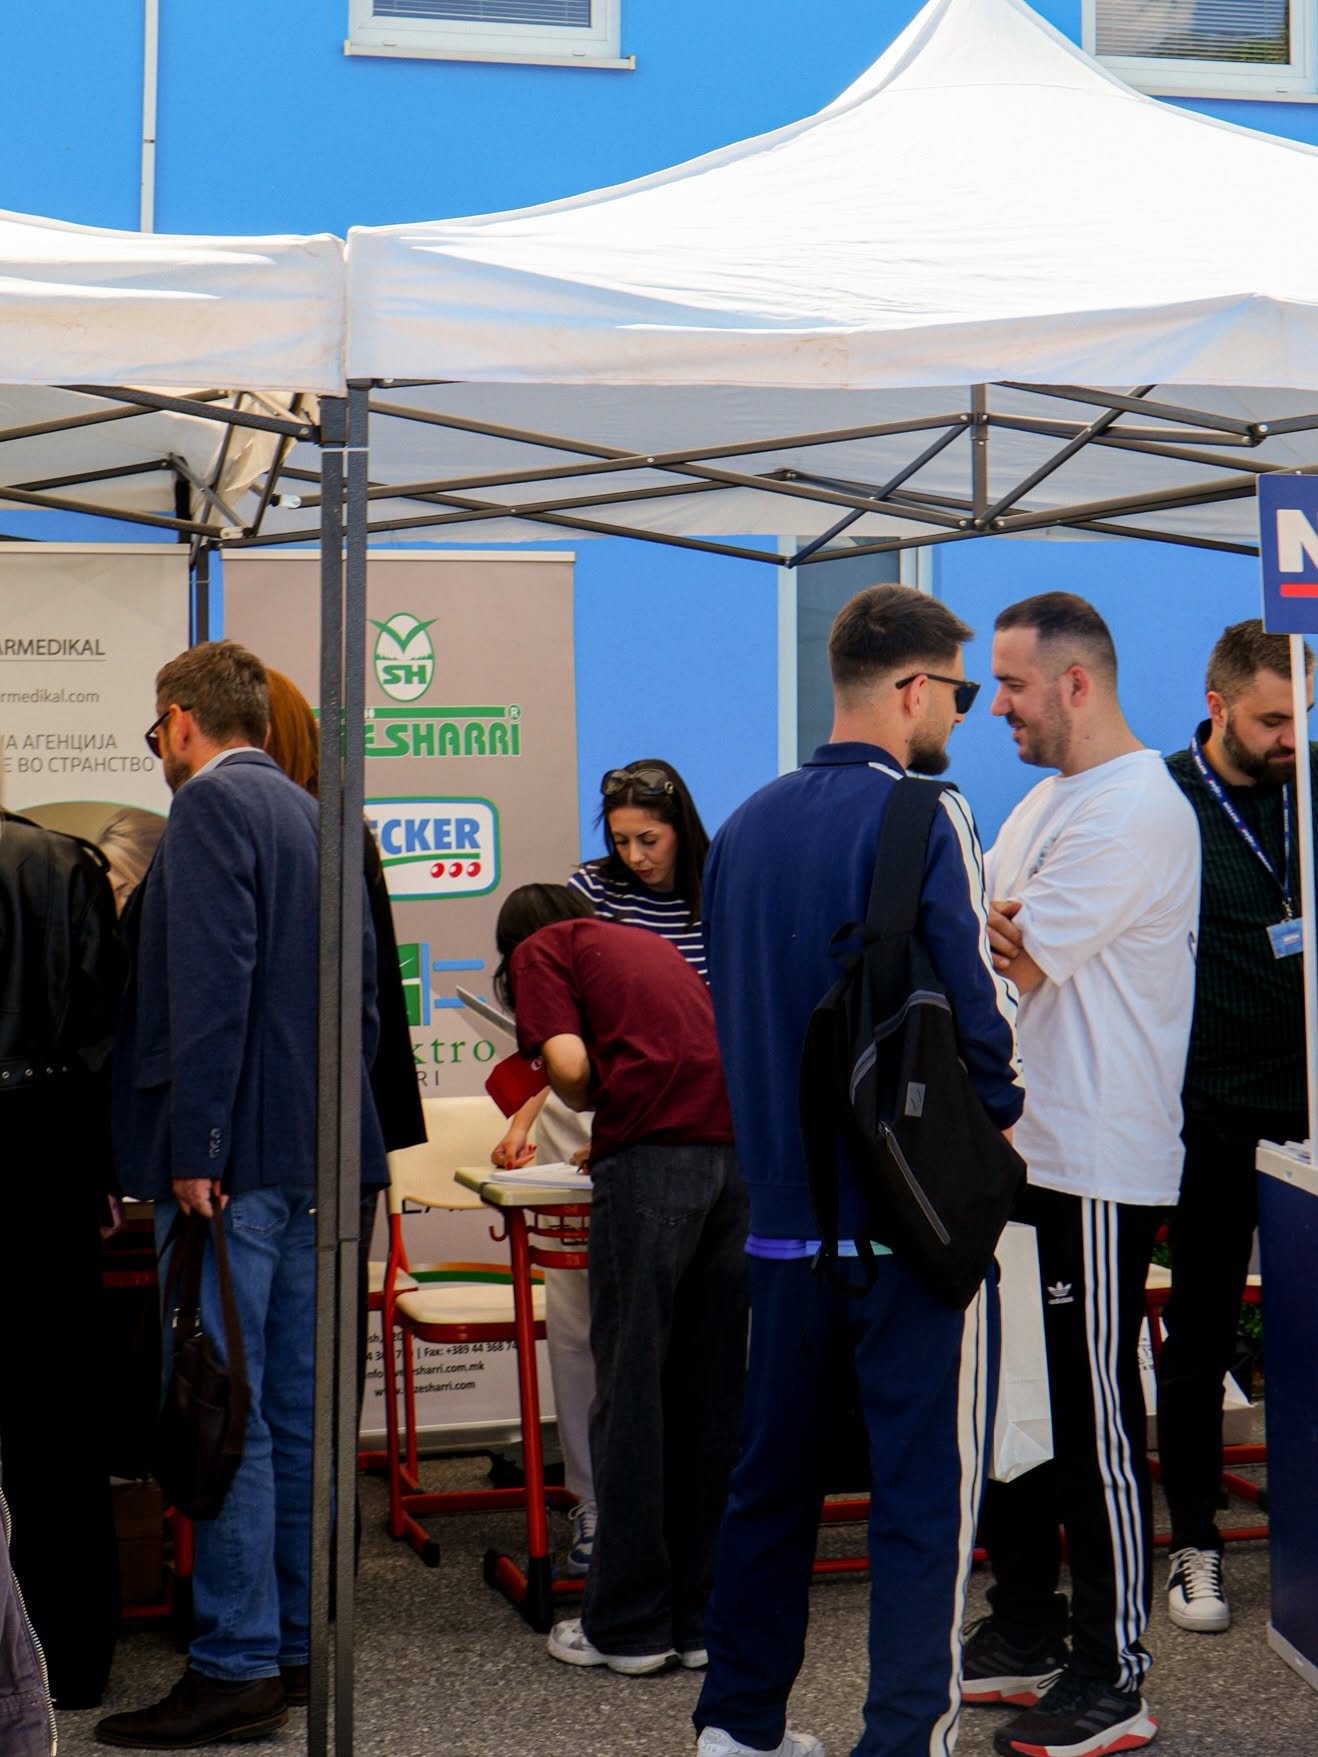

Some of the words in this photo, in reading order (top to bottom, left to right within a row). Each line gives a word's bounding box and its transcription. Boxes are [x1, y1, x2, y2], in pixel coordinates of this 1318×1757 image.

[0, 638, 106, 656] RMEDIKAL
[383, 664, 427, 685] SH
[22, 733, 118, 752] АГЕНЦИЈА
[18, 757, 43, 773] ВО
[48, 756, 155, 773] СТРАНСТВО
[366, 818, 480, 855] CKER
